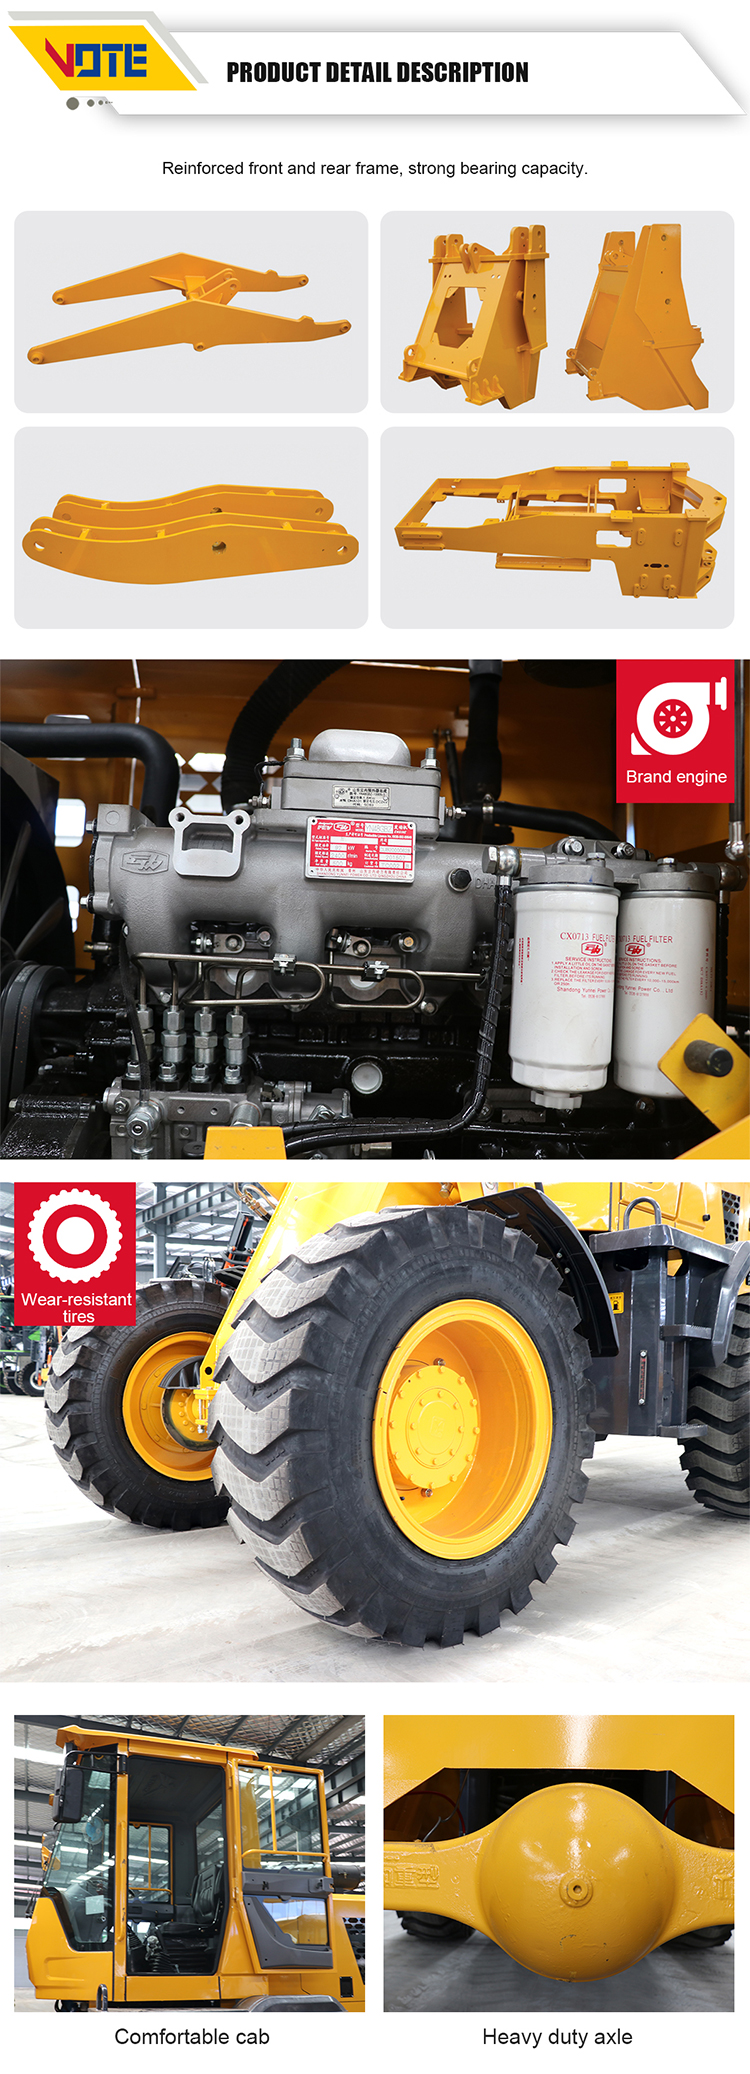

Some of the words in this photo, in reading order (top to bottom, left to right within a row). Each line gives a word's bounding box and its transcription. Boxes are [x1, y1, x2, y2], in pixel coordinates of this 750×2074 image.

[560, 932, 589, 940] CX0713
[592, 933, 605, 941] FUEL
[632, 934, 648, 943] FUEL
[648, 935, 674, 944] FILTER
